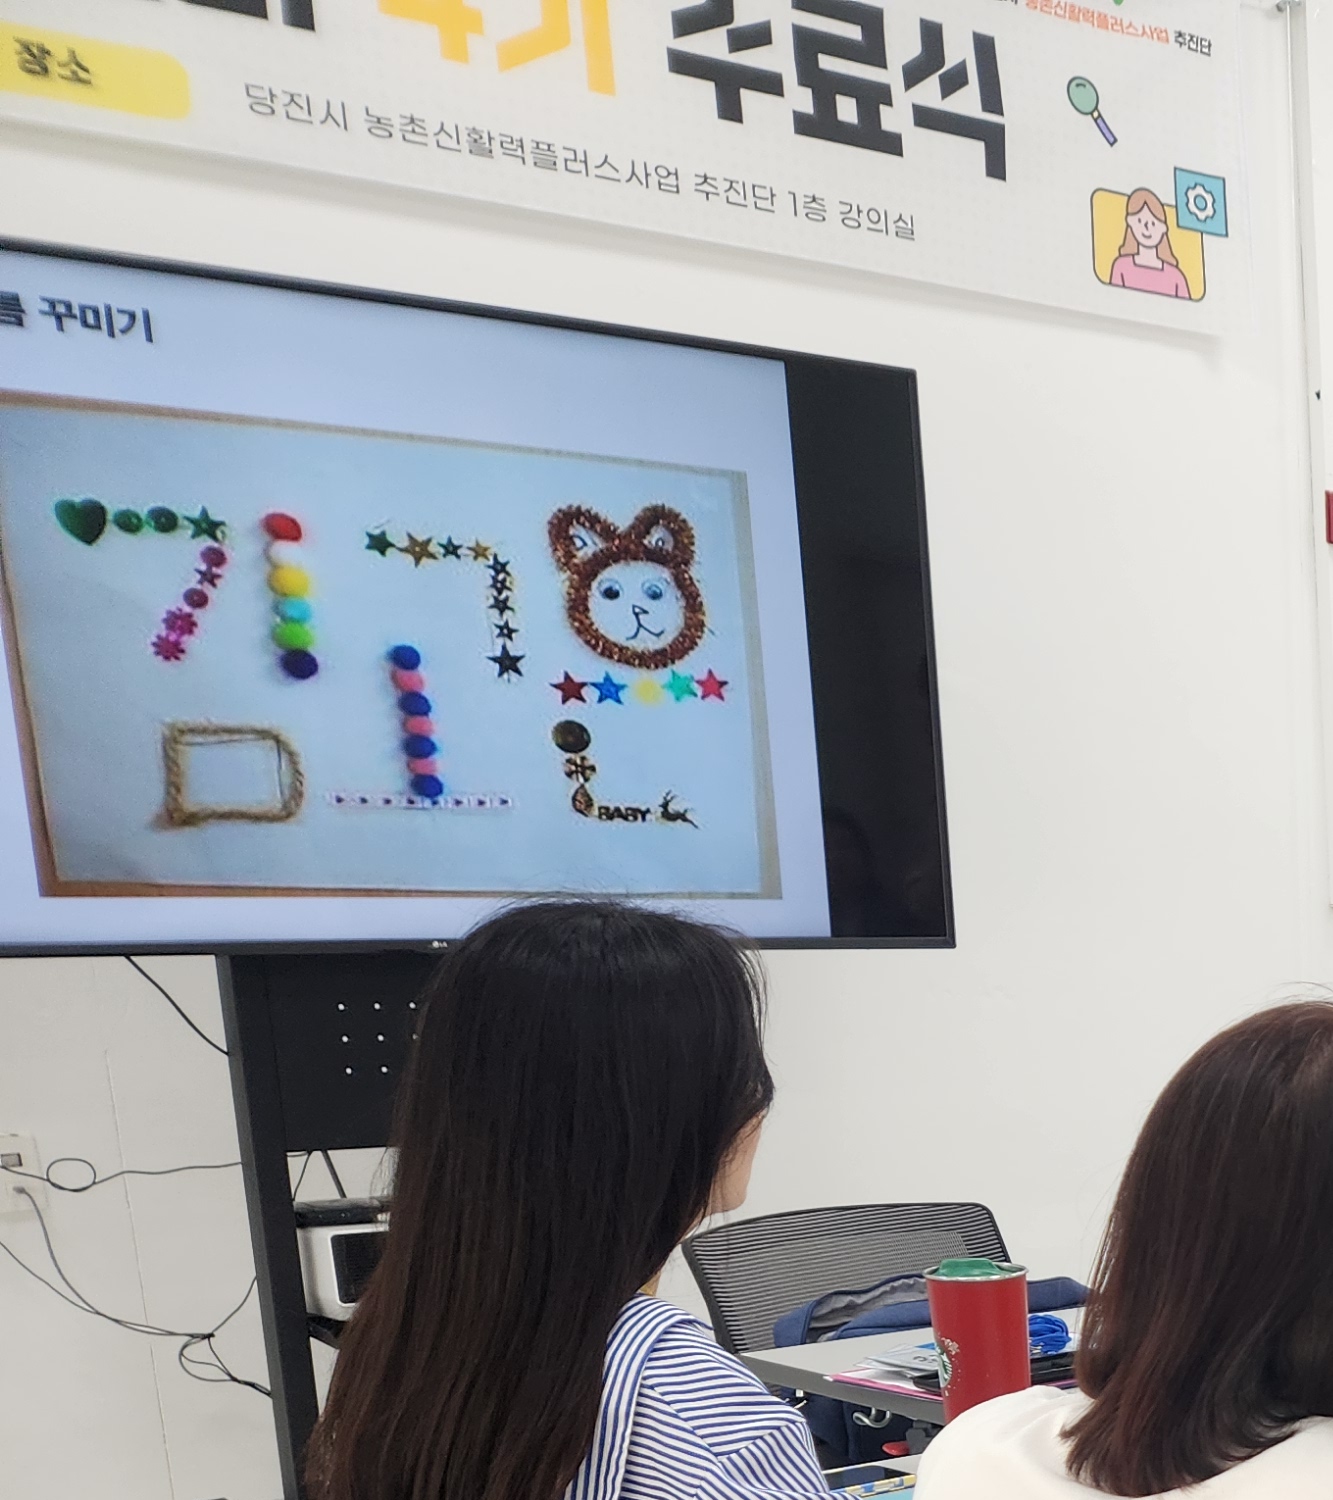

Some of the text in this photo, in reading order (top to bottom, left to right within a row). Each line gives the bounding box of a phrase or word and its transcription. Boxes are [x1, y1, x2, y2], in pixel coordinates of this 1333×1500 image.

[13, 36, 92, 86] 장소
[1174, 29, 1212, 57] 추진단
[666, 0, 1008, 182] 수료식
[243, 81, 917, 241] 당진시 농촌신활력플러스사업 추진단 1층 강의실
[38, 295, 154, 343] 꾸미기
[597, 805, 651, 823] BABY
